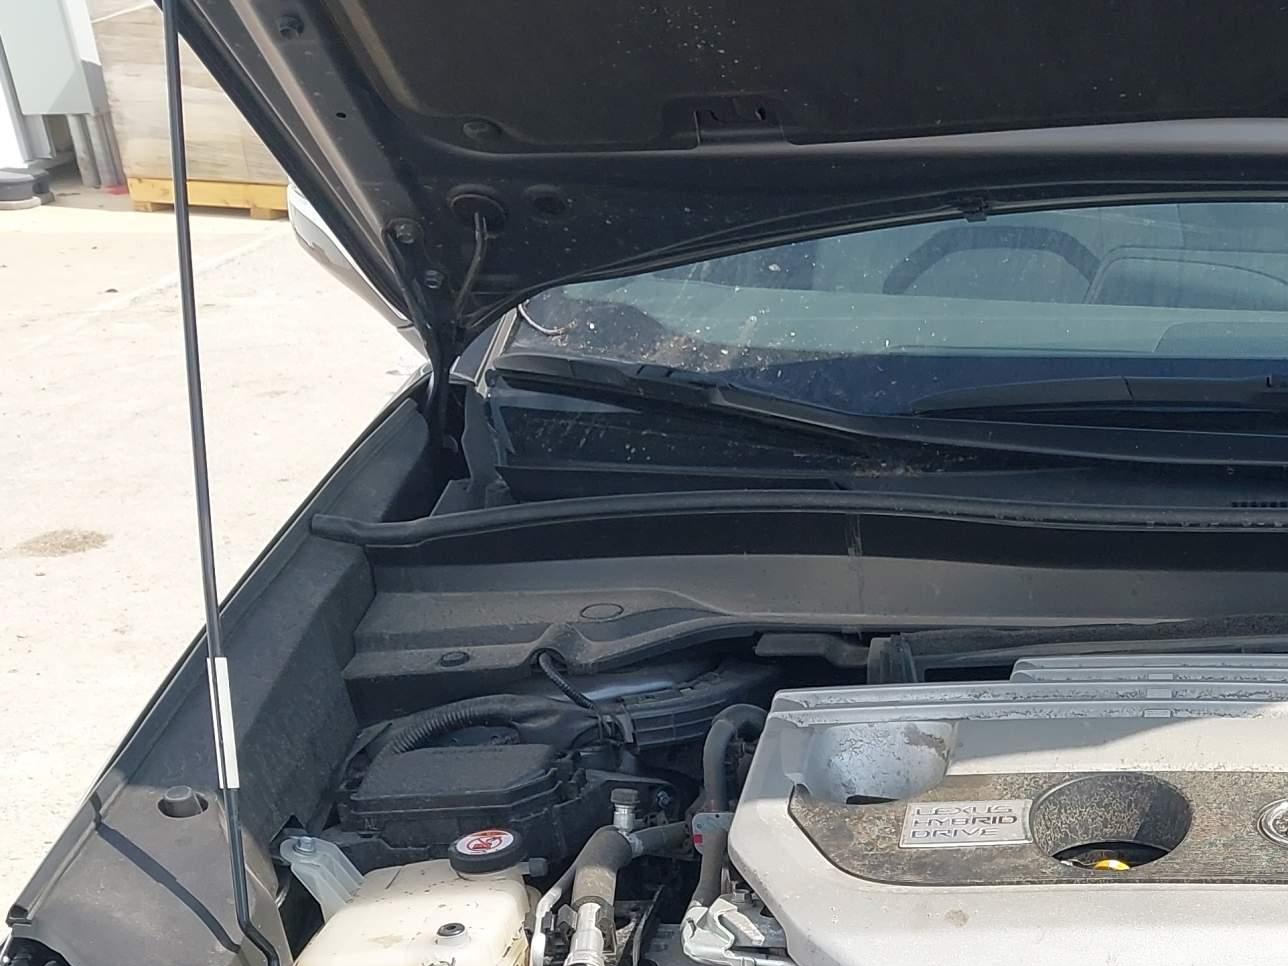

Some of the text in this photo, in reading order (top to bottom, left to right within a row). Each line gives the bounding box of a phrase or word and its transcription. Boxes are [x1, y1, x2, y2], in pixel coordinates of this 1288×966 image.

[914, 805, 1013, 816] LEXUS
[912, 815, 1018, 827] HYBRID
[911, 828, 999, 839] DRIVE
